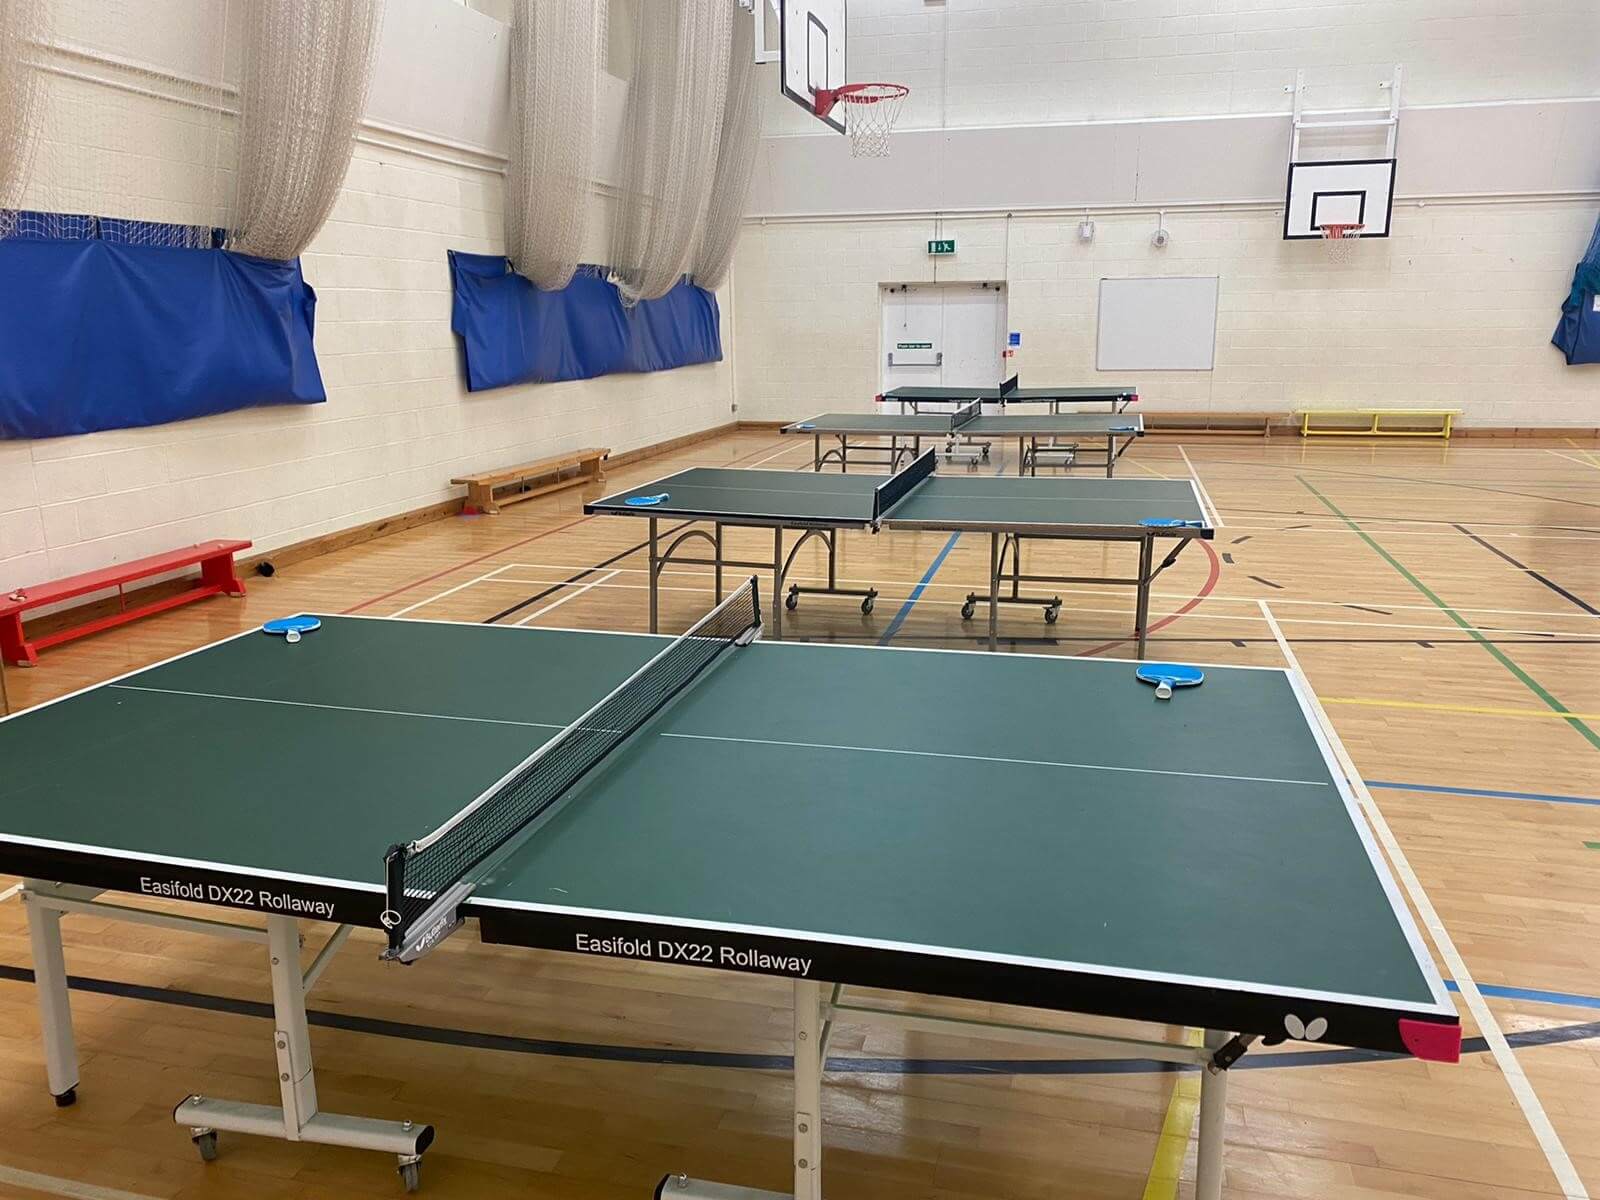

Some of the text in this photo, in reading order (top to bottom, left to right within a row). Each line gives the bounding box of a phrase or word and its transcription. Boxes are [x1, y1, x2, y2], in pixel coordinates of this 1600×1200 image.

[140, 876, 335, 919] Easifold DX22 Rollaway
[575, 933, 812, 976] Easifold DX22 Rollaway
